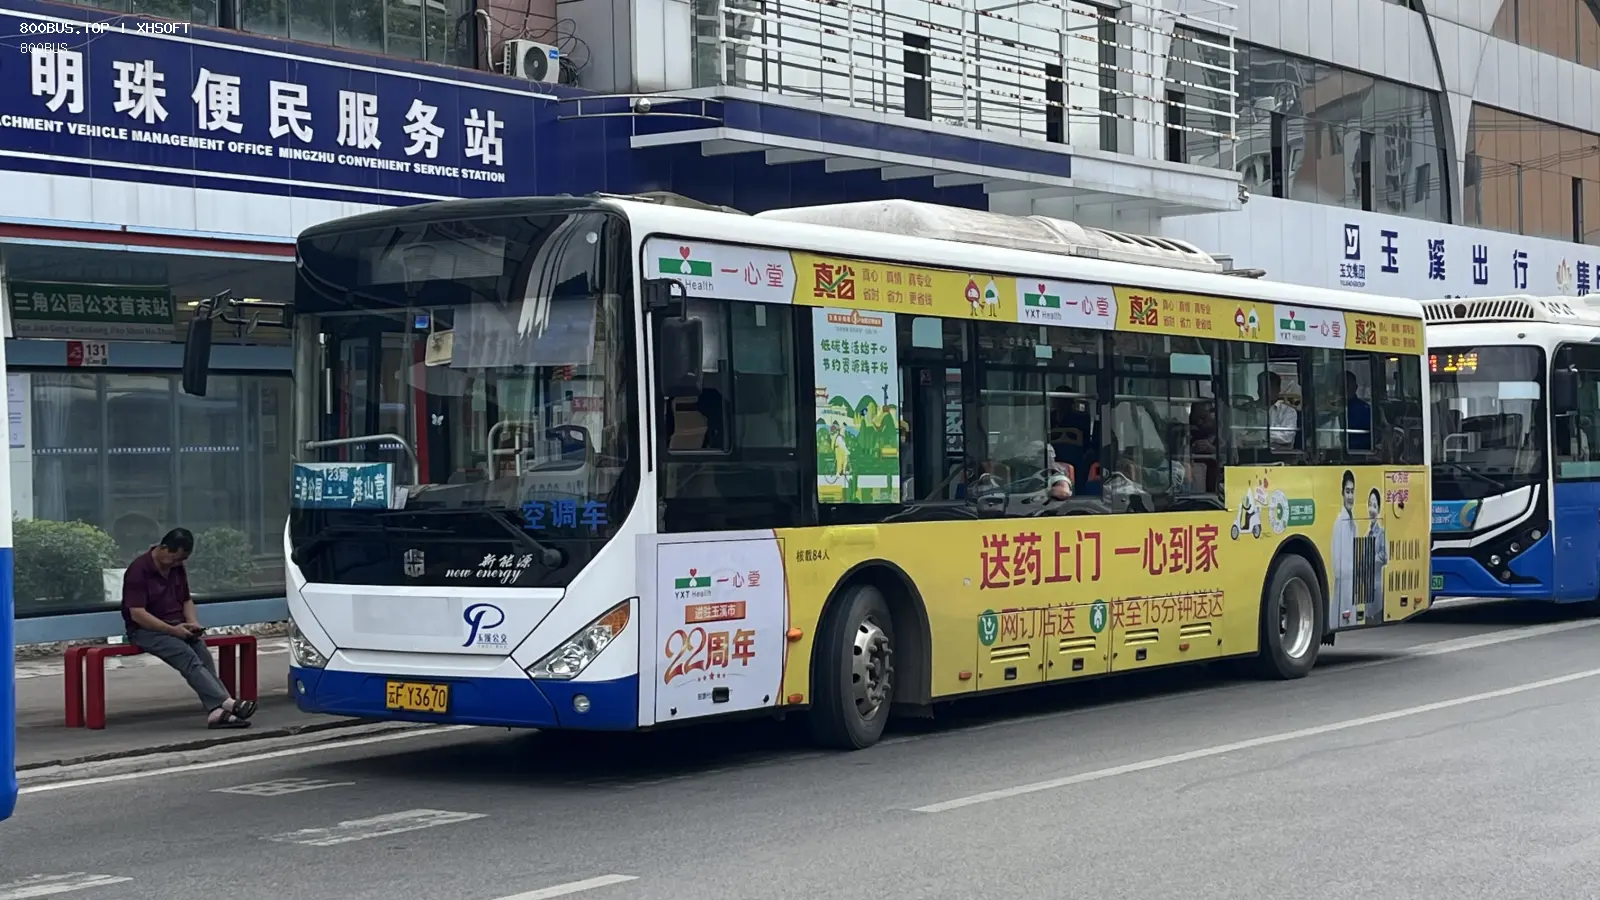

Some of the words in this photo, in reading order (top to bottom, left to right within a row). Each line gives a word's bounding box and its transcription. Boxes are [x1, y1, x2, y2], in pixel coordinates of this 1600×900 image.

[31, 48, 505, 166] 明珠便民服务站
[0, 115, 63, 133] CHMENT
[67, 122, 128, 140] VEHICLE
[131, 130, 225, 151] MANAGEMENT
[228, 140, 273, 157] OFFICE
[279, 147, 335, 164] MINGZHU
[337, 154, 410, 172] CONVENIENT
[413, 163, 459, 178] SERVICE
[461, 168, 506, 183] STATION
[1380, 230, 1529, 289] 玉溪出行
[685, 279, 714, 291] Health
[721, 262, 784, 288] 一心堂
[14, 292, 170, 317] 三角公园公交首末站
[1025, 309, 1040, 319] YXT
[1041, 310, 1062, 320] Health
[1066, 296, 1109, 316] 一心堂
[1309, 320, 1341, 338] 一心堂
[86, 344, 106, 357] 131
[522, 500, 609, 533] 空调车
[478, 553, 533, 569] 新能源
[980, 530, 1101, 590] 送药上门
[1114, 524, 1219, 576] 一心到家
[445, 568, 473, 578] new
[476, 568, 524, 585] energy
[716, 570, 760, 587] 一心堂
[675, 591, 690, 599] YXT
[1001, 602, 1076, 642] 网订店送
[1109, 588, 1224, 630] 快至15分钟送达
[664, 627, 756, 685] 22周年
